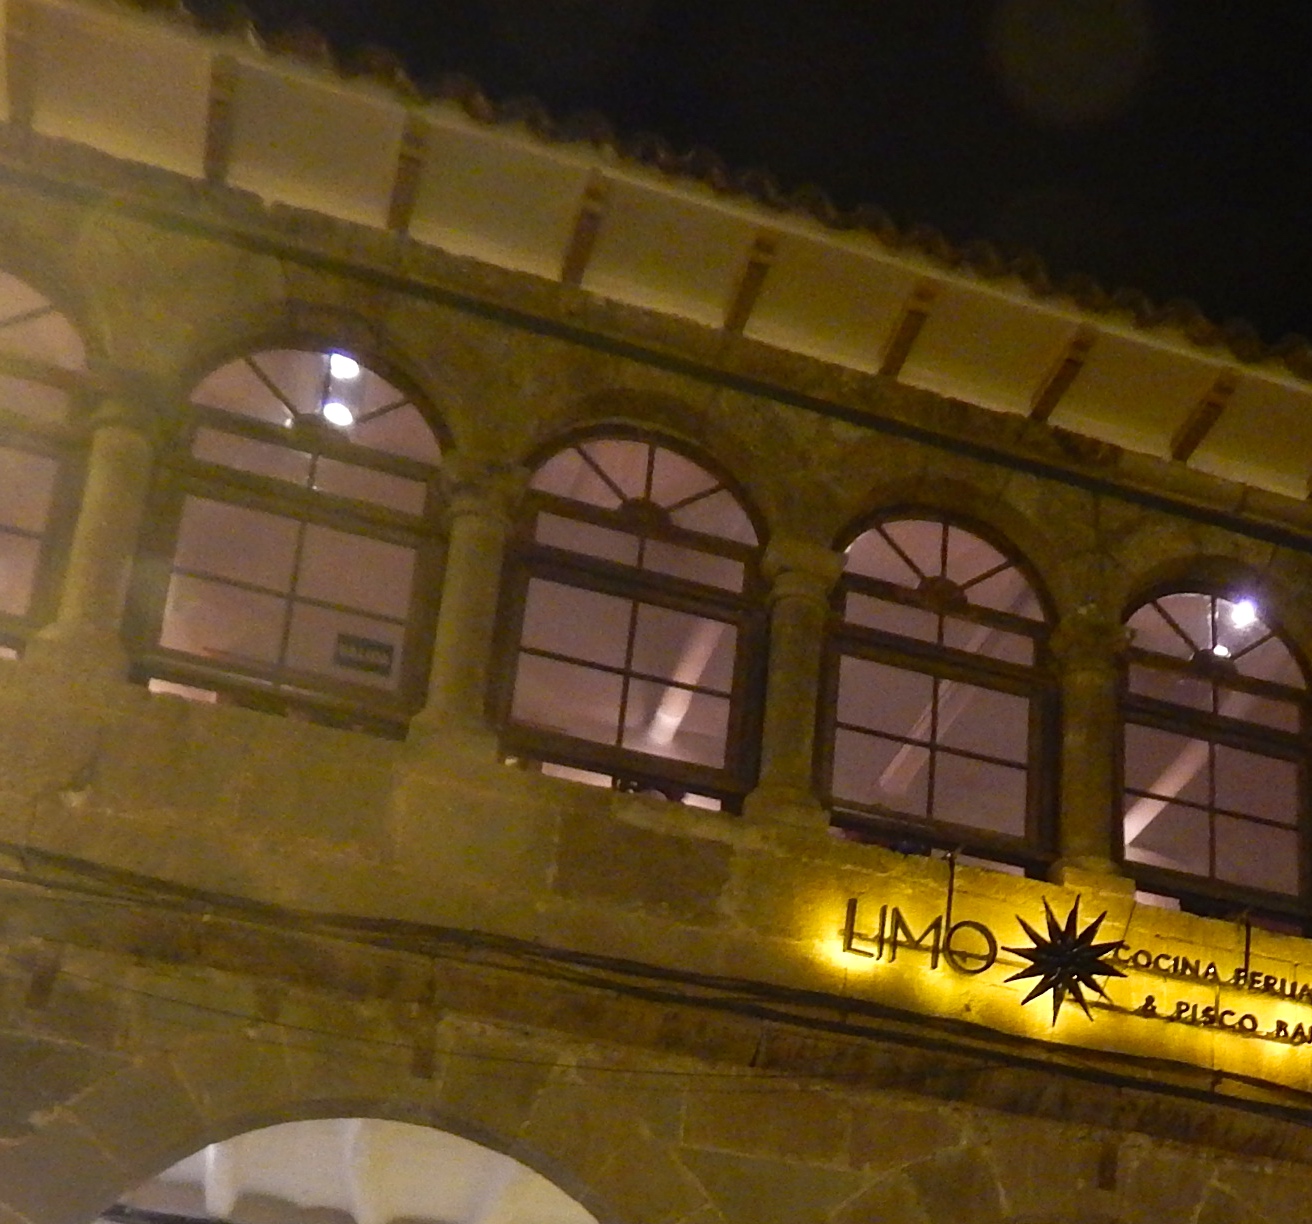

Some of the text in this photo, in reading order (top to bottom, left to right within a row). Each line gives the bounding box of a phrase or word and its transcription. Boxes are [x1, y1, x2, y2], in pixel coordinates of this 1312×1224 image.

[842, 898, 997, 974] LIMO
[1114, 943, 1220, 981] COCINA
[1142, 995, 1157, 1016] &
[1174, 1001, 1258, 1033] PISCO
